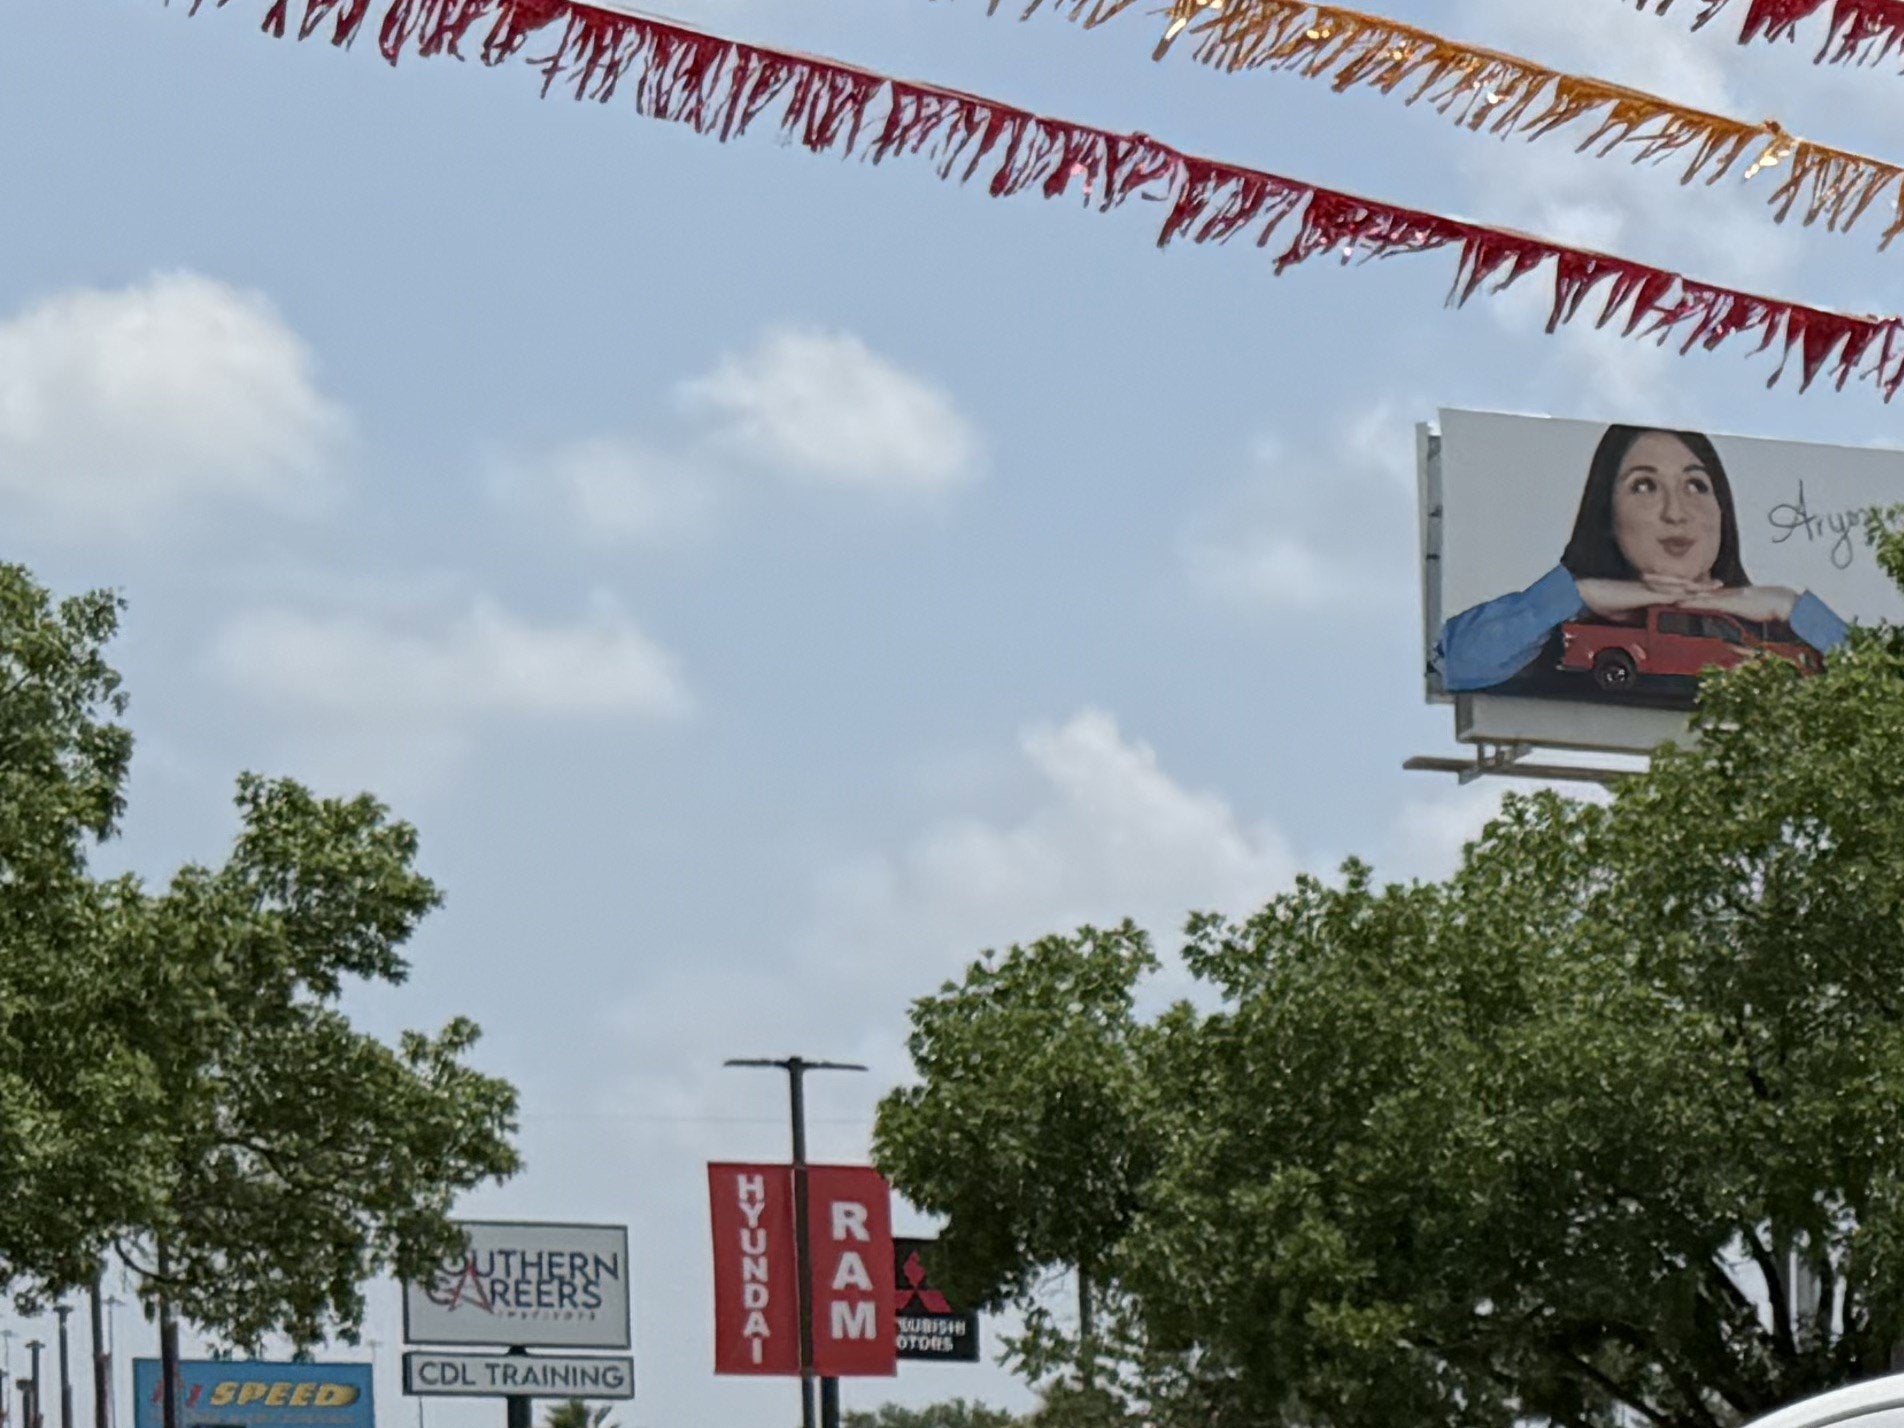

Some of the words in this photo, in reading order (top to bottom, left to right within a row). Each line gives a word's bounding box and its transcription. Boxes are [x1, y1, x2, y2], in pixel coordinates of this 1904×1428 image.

[433, 1248, 619, 1281] OUTHERN
[737, 1174, 770, 1365] HYUNDAI
[831, 1202, 877, 1340] RAM
[896, 1333, 953, 1352] OTORS
[418, 1361, 476, 1387] CDL
[484, 1362, 625, 1390] TRAINING
[210, 1381, 362, 1408] SPEED
